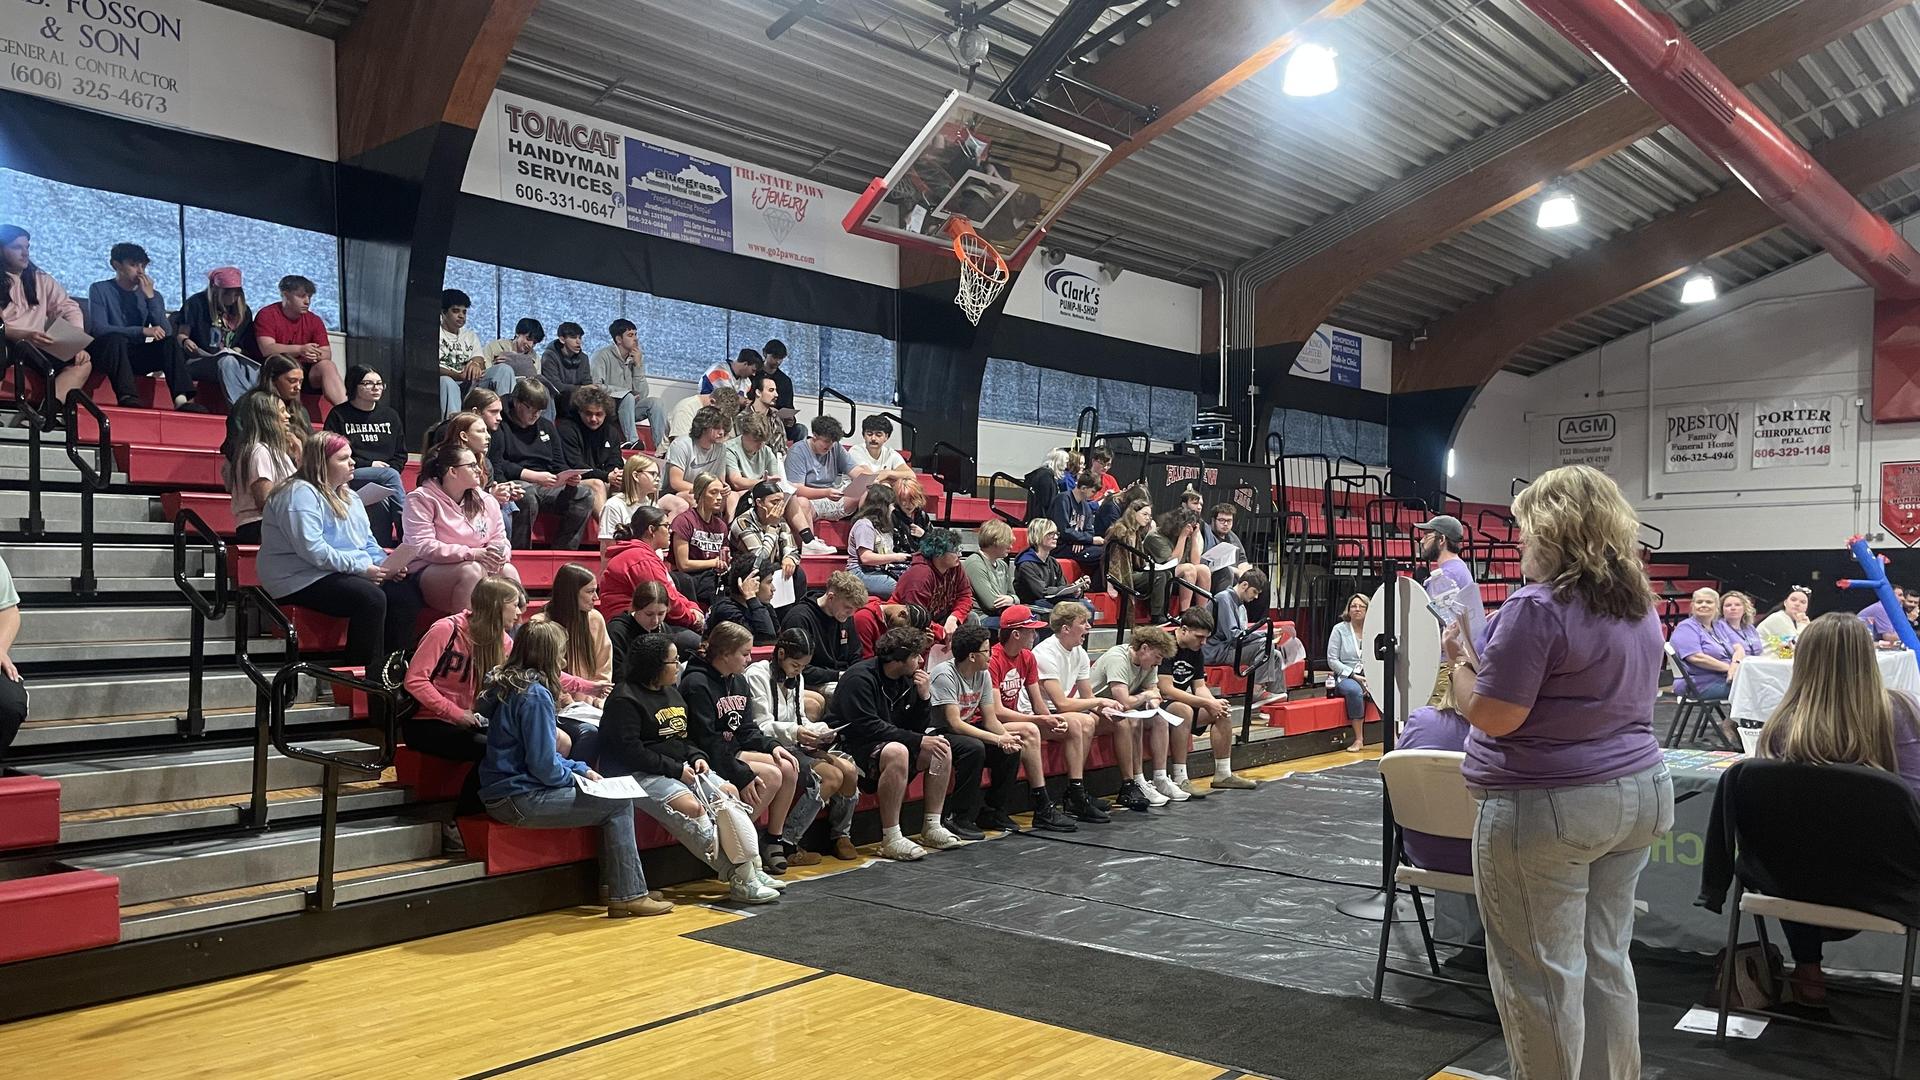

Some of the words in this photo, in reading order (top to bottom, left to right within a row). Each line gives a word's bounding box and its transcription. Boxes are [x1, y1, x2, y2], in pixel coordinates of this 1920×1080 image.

[67, 0, 181, 42] FOSSON
[40, 16, 64, 41] &
[79, 24, 140, 60] SON
[11, 62, 62, 90] (606)
[72, 77, 167, 113] 325-4673
[75, 56, 178, 93] CONTRACTOR
[505, 104, 620, 159] TOMCAT
[508, 138, 619, 180] HANDYMAN
[517, 160, 613, 196] SERVICES
[655, 168, 722, 194] Bluegrass
[734, 166, 792, 191] TRI-STATE
[796, 183, 825, 199] PAWN
[515, 183, 615, 219] 606-331-0647
[755, 187, 809, 222] JEWELRY
[748, 243, 815, 264] www.go2pawn.com
[1061, 280, 1100, 305] Clark's
[1060, 299, 1098, 316] PUMP-N-SHOP
[345, 422, 392, 435] CARHARTT
[1565, 418, 1608, 434] AGM
[1668, 412, 1739, 443] PRESTON
[1757, 409, 1831, 426] PORTER
[1688, 433, 1717, 441] Family
[1754, 425, 1832, 438] CHIROPRACTIC
[1670, 451, 1734, 462] 606-325-4946
[1671, 442, 1704, 450] Funeral
[1708, 441, 1734, 449] Home
[1754, 445, 1831, 458] 606-329-1148
